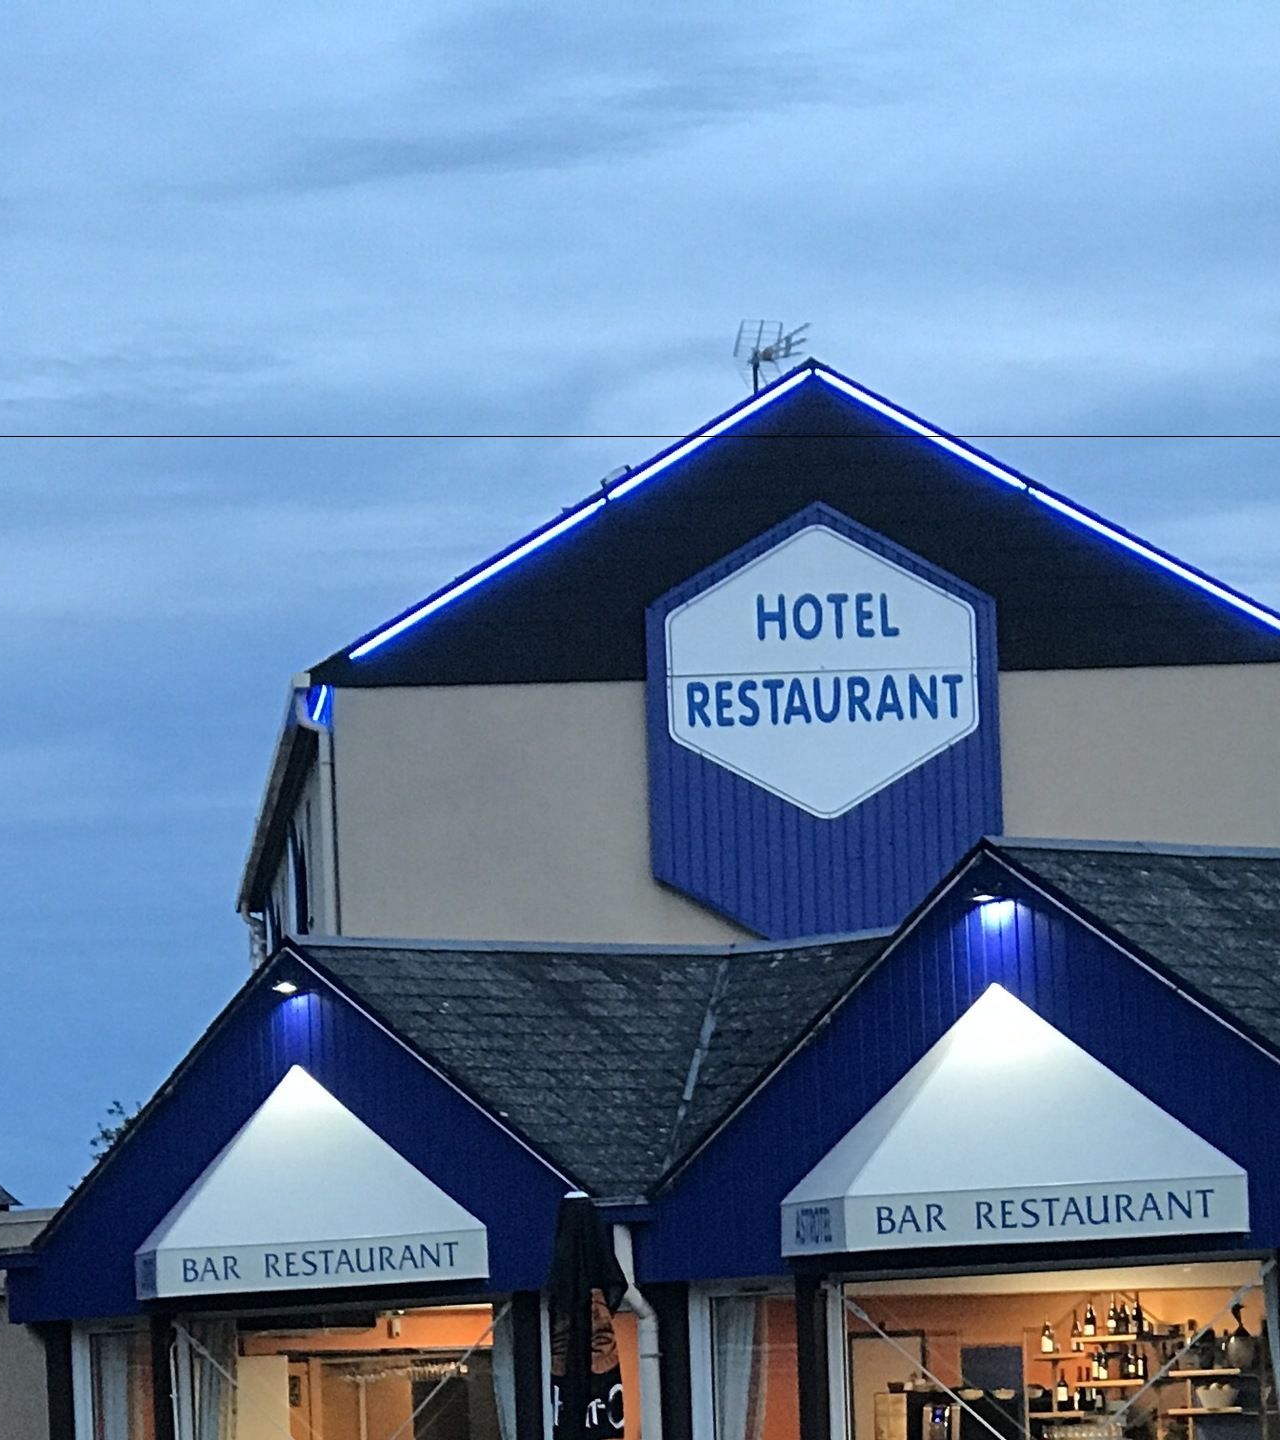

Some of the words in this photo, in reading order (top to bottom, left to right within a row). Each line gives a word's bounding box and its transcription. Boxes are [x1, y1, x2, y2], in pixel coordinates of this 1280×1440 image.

[756, 592, 901, 641] HOTEL
[686, 674, 964, 728] RESTAURANT
[875, 1202, 947, 1235] BAR
[974, 1188, 1215, 1231] RESTAURANT
[182, 1255, 242, 1283] BAR
[264, 1241, 460, 1279] RESTAURANT
